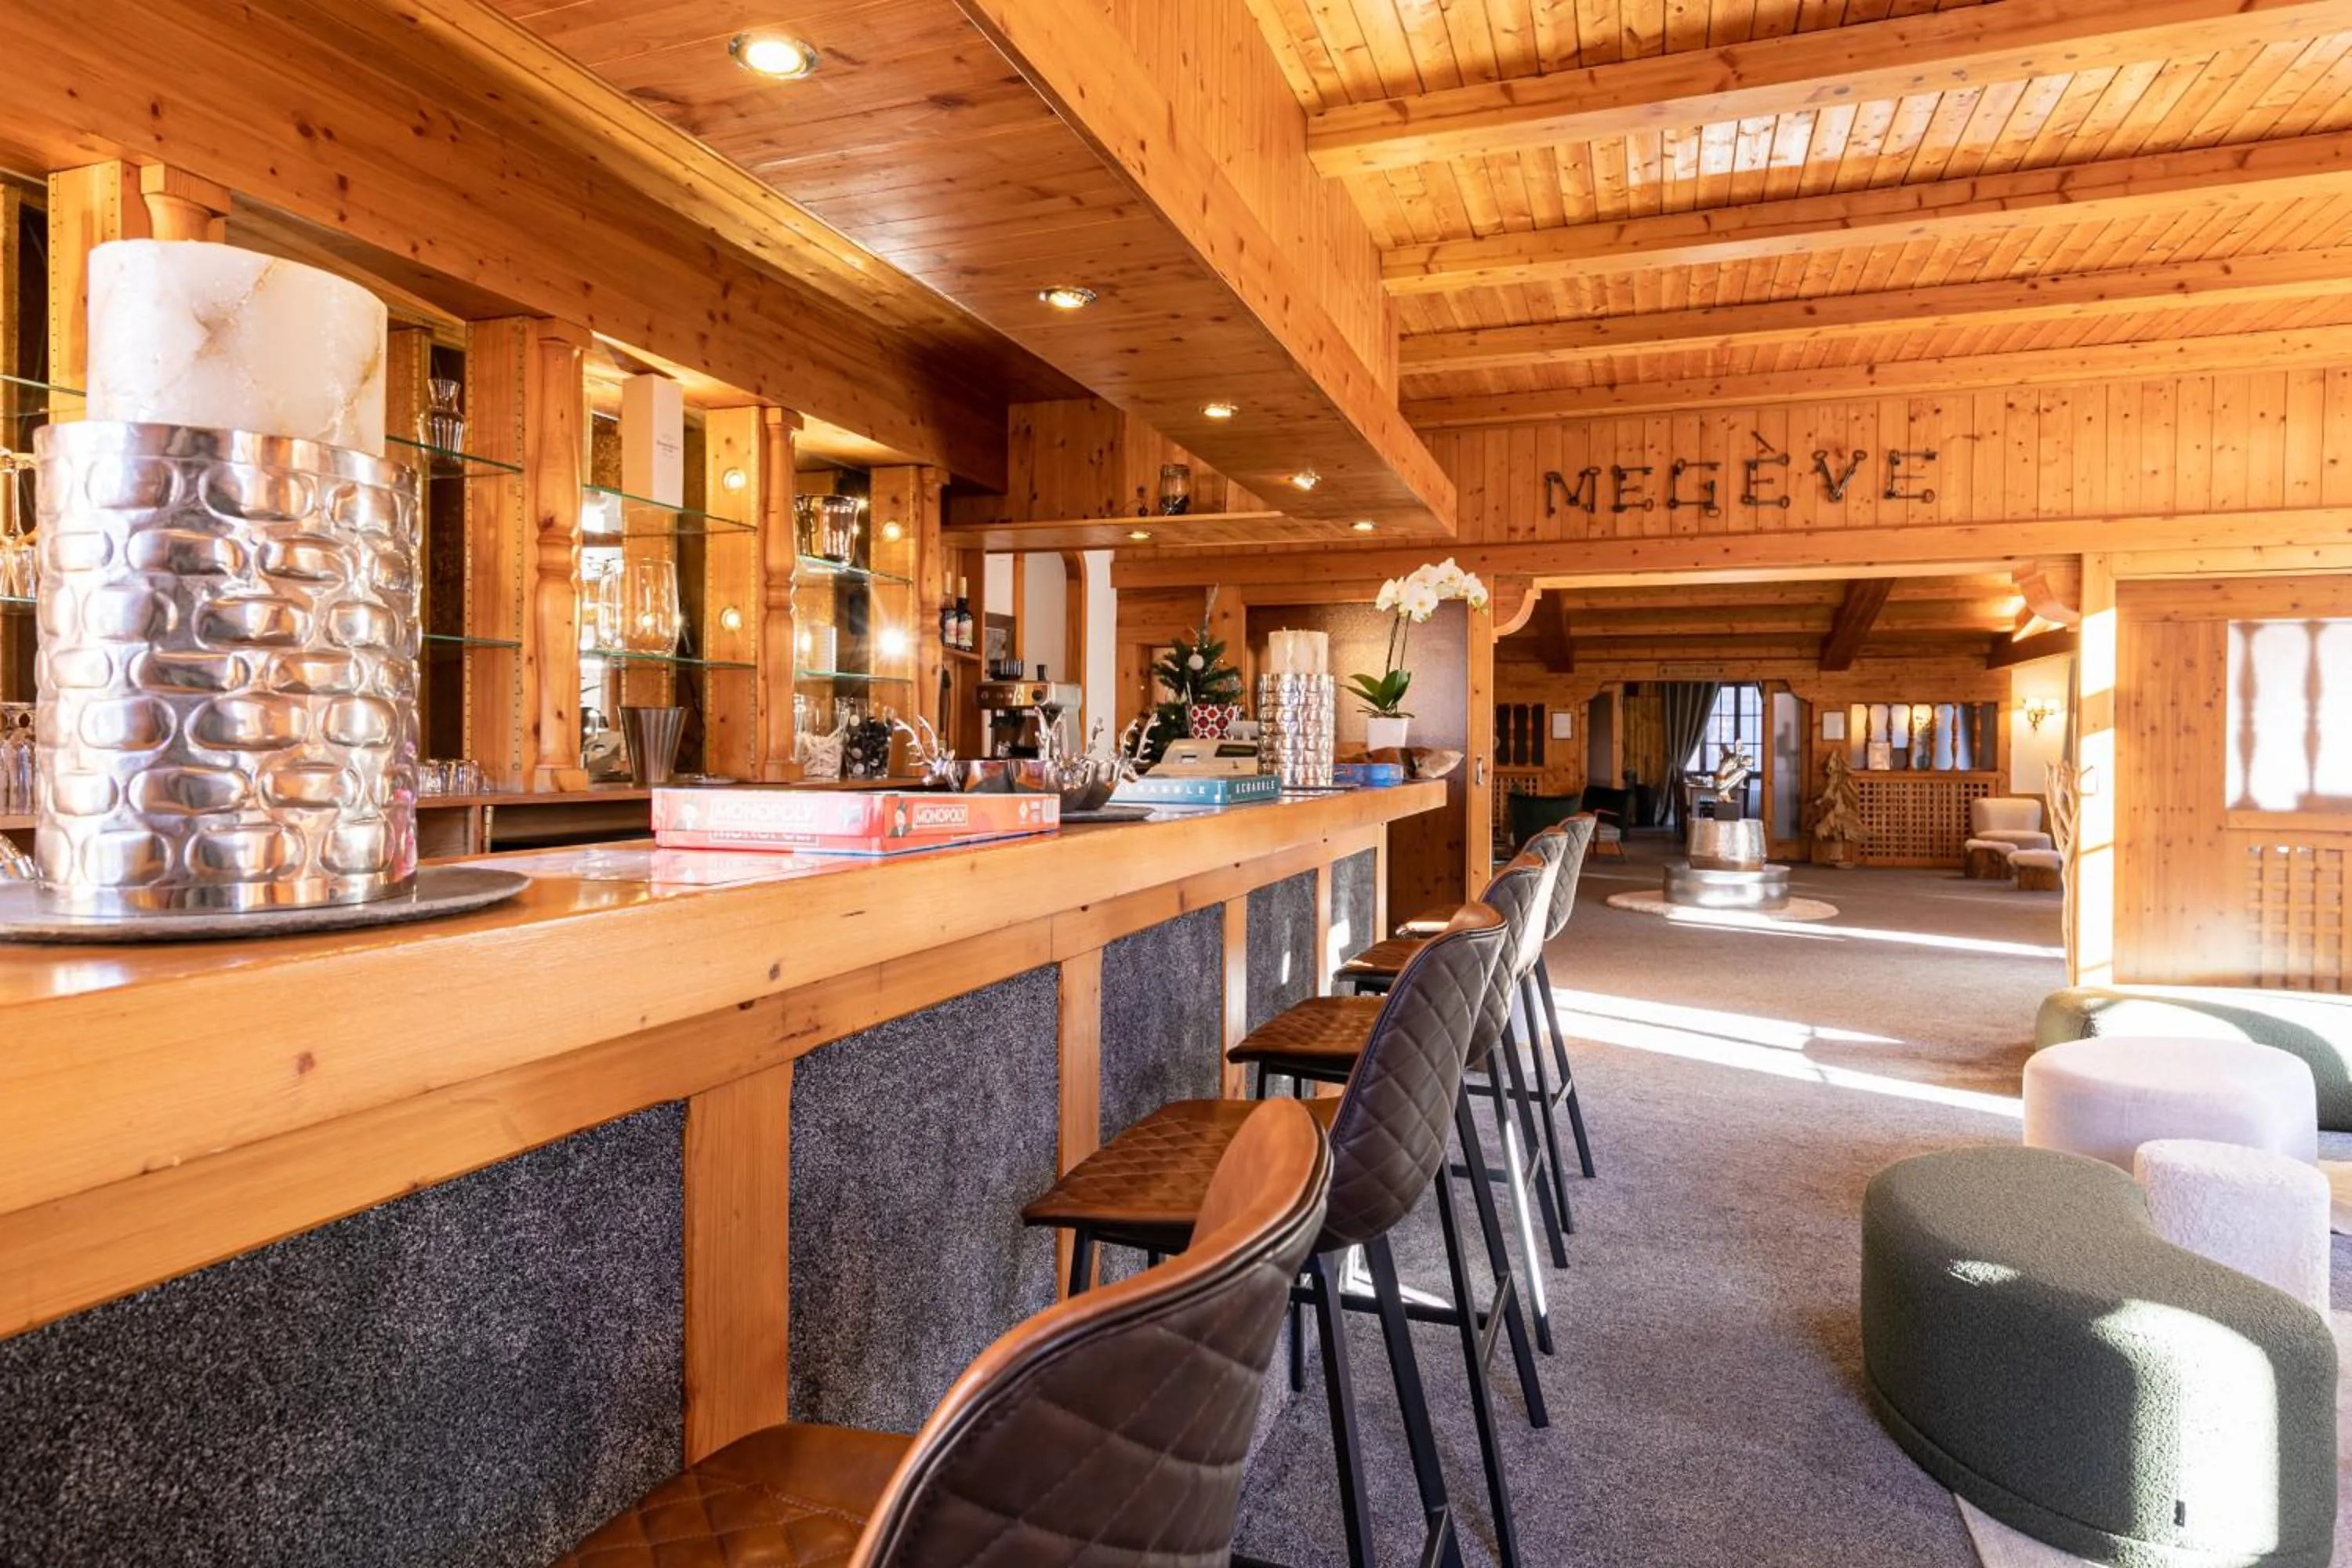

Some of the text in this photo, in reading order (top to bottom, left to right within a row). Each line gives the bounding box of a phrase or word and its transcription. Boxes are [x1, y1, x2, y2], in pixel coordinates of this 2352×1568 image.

[1544, 430, 1937, 517] MEGÈVE
[713, 800, 816, 822] MONOPOLY
[915, 807, 967, 824] MONOPOLY
